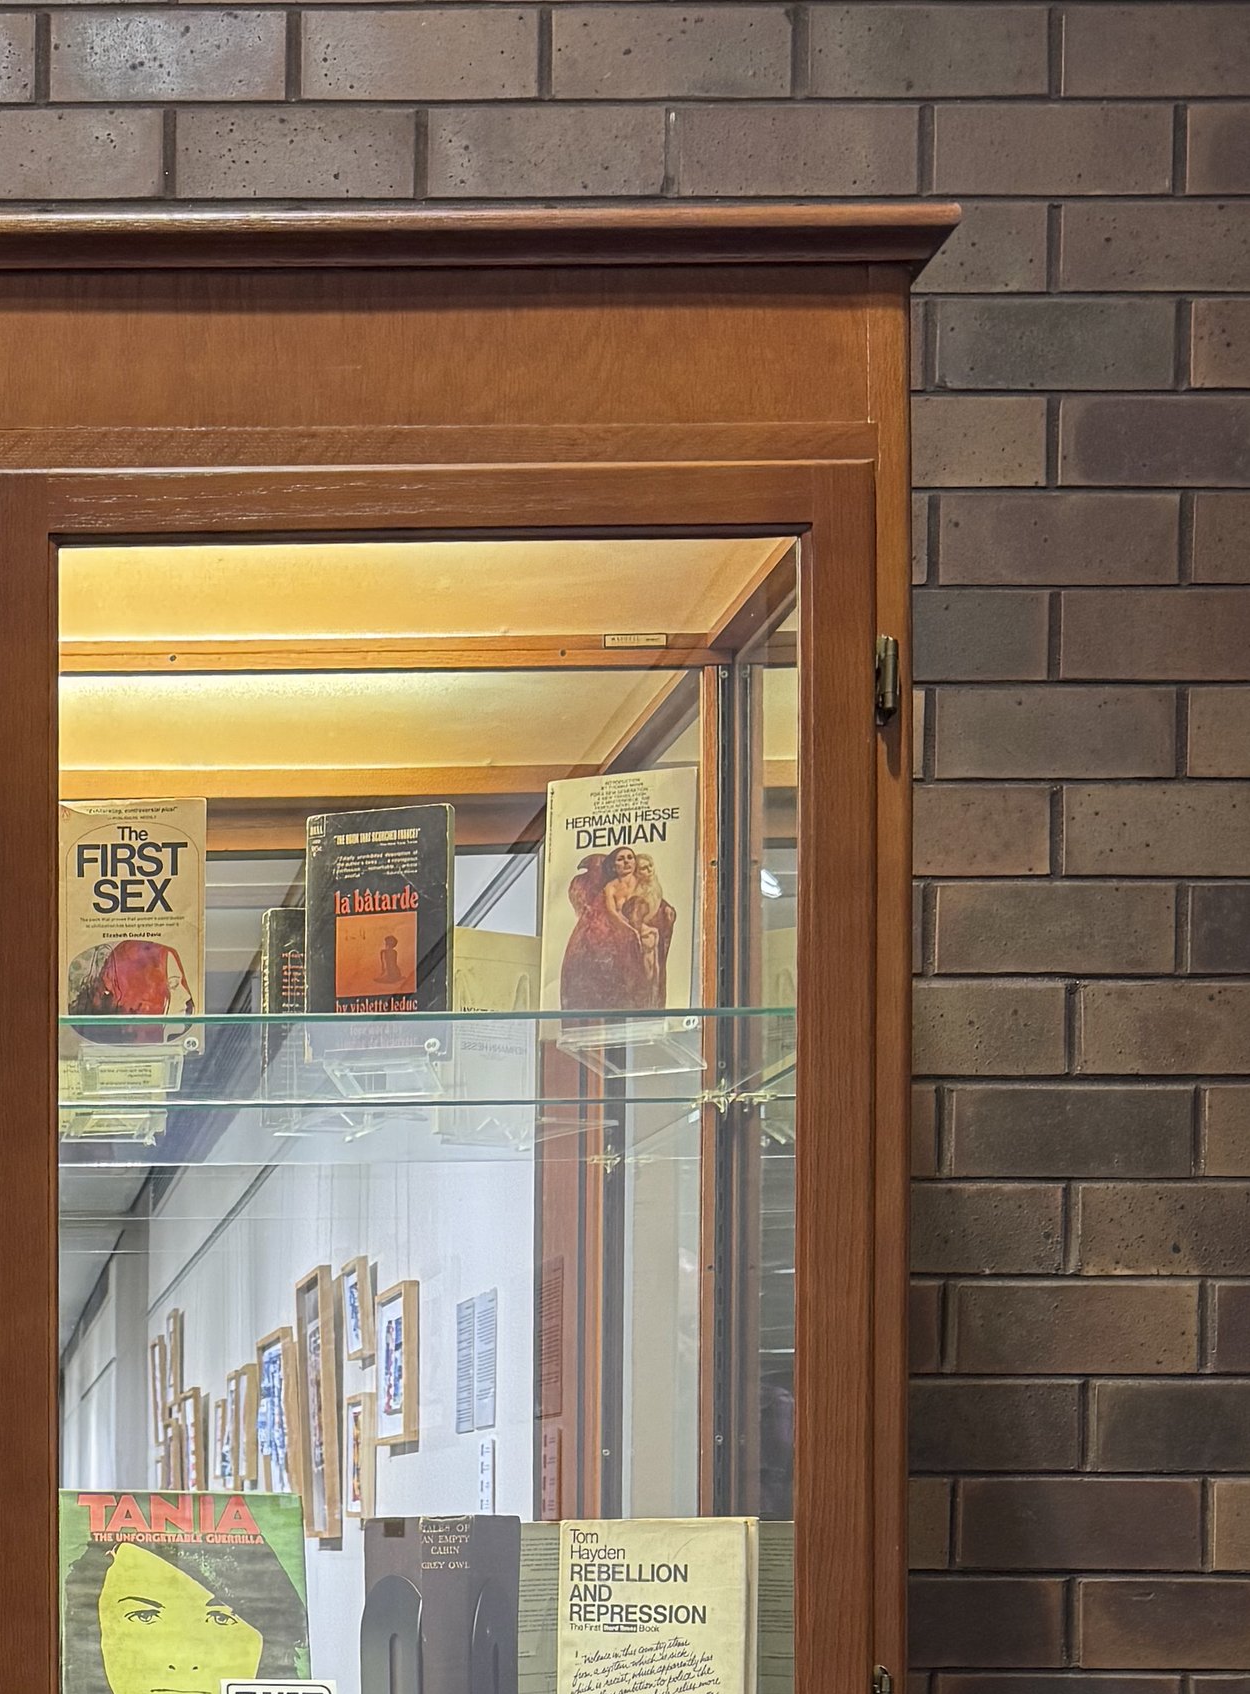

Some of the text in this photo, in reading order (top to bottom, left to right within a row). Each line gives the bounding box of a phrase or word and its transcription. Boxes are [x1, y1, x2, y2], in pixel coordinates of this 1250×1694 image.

[566, 808, 680, 830] HERMANN HESSE
[117, 826, 148, 841] The
[576, 822, 666, 850] DEMIAN
[77, 842, 188, 878] FIRST
[93, 878, 173, 914] SEX
[334, 885, 419, 914] la bâtarde
[350, 996, 418, 1012] violette leduc
[78, 1494, 260, 1534] TANIA
[93, 1533, 264, 1544] THE UNFORGETTABLE GUERRILLA
[422, 1534, 470, 1544] AN EMPTY
[570, 1529, 598, 1544] Tom
[431, 1546, 460, 1554] CABIN
[570, 1545, 626, 1562] Hayden
[448, 1561, 470, 1569] OWL
[570, 1564, 688, 1582] REBELLION
[570, 1584, 612, 1602] AND
[570, 1604, 706, 1624] REPRESSION
[570, 1623, 660, 1632] The First Book
[656, 1677, 665, 1686] to
[667, 1670, 694, 1688] police
[696, 1666, 714, 1677] the
